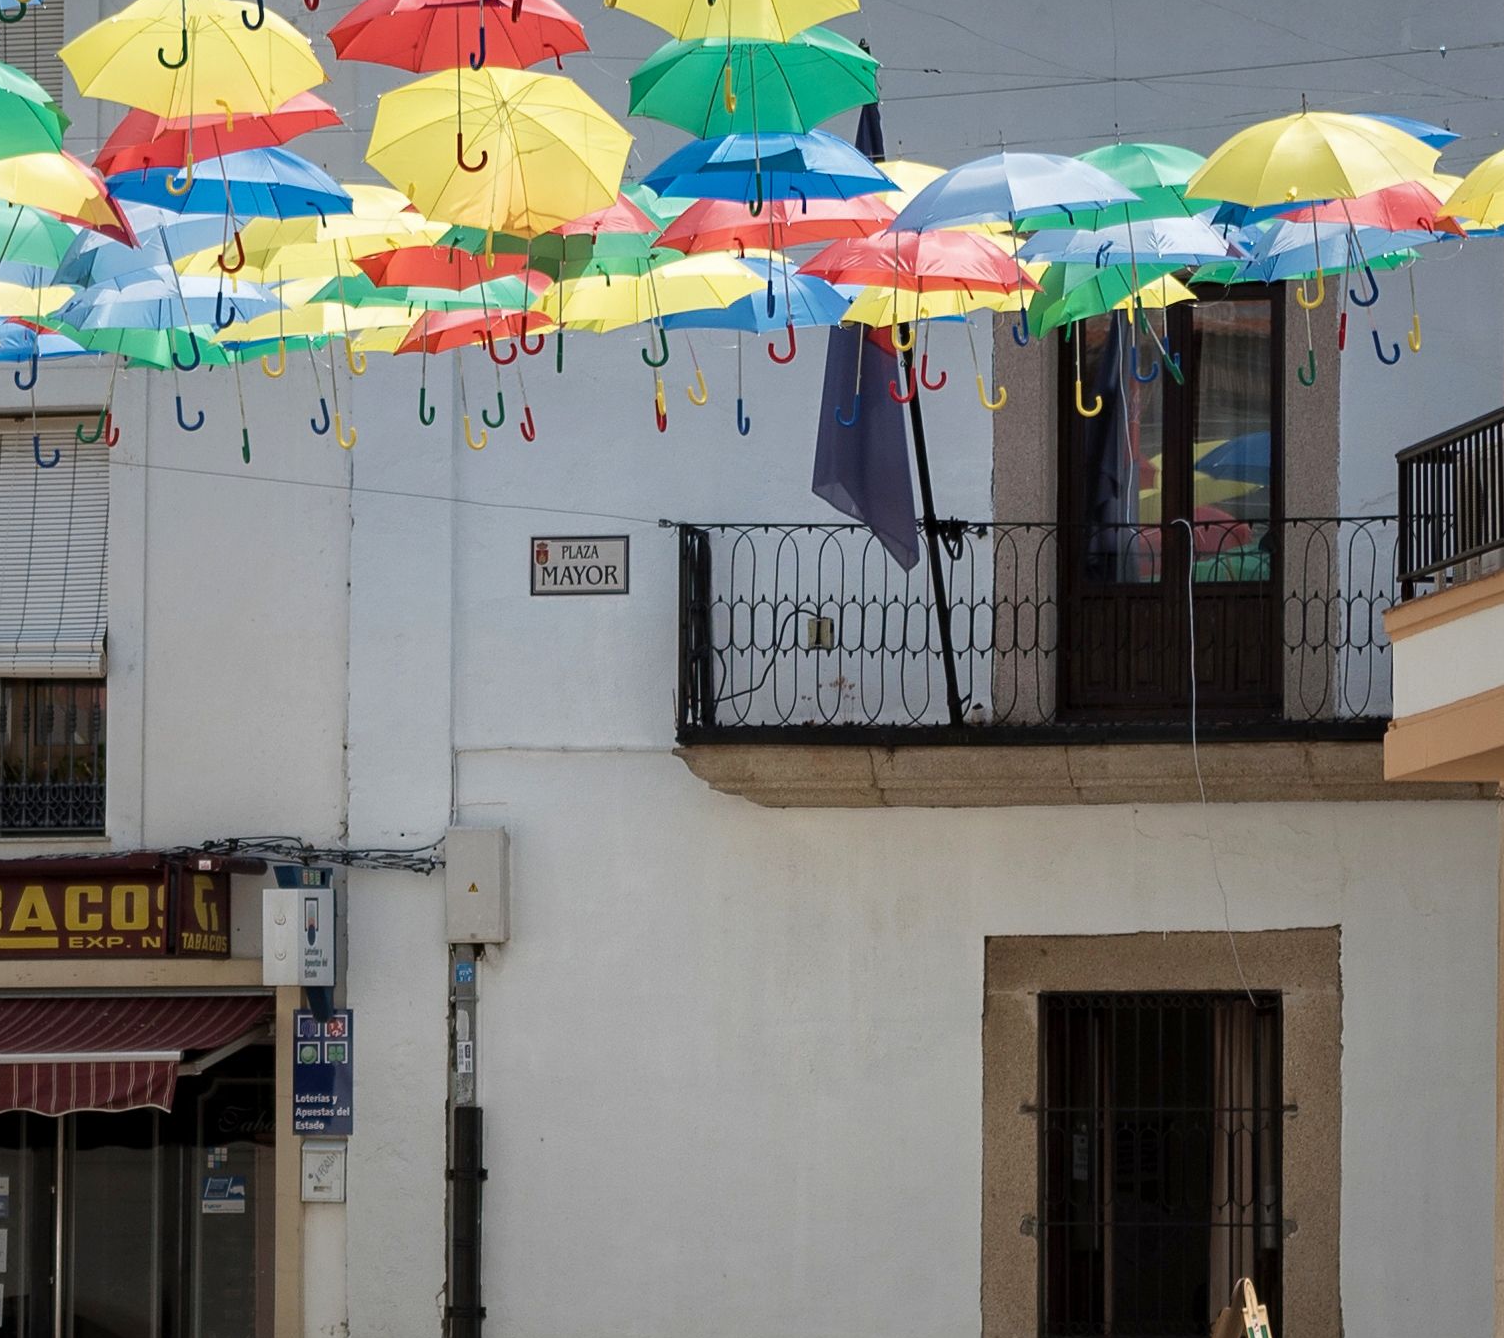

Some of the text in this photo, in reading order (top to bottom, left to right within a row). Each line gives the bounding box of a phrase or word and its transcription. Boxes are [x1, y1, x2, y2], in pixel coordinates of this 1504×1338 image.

[561, 545, 599, 560] PLAZA
[541, 565, 619, 586] MAYOR
[69, 936, 161, 949] EXP. N
[182, 932, 228, 953] TABACOS
[295, 1093, 338, 1105] Loterías y
[218, 1106, 276, 1132] Taba
[295, 1107, 350, 1118] Apuestas del
[295, 1121, 325, 1130] Estado
